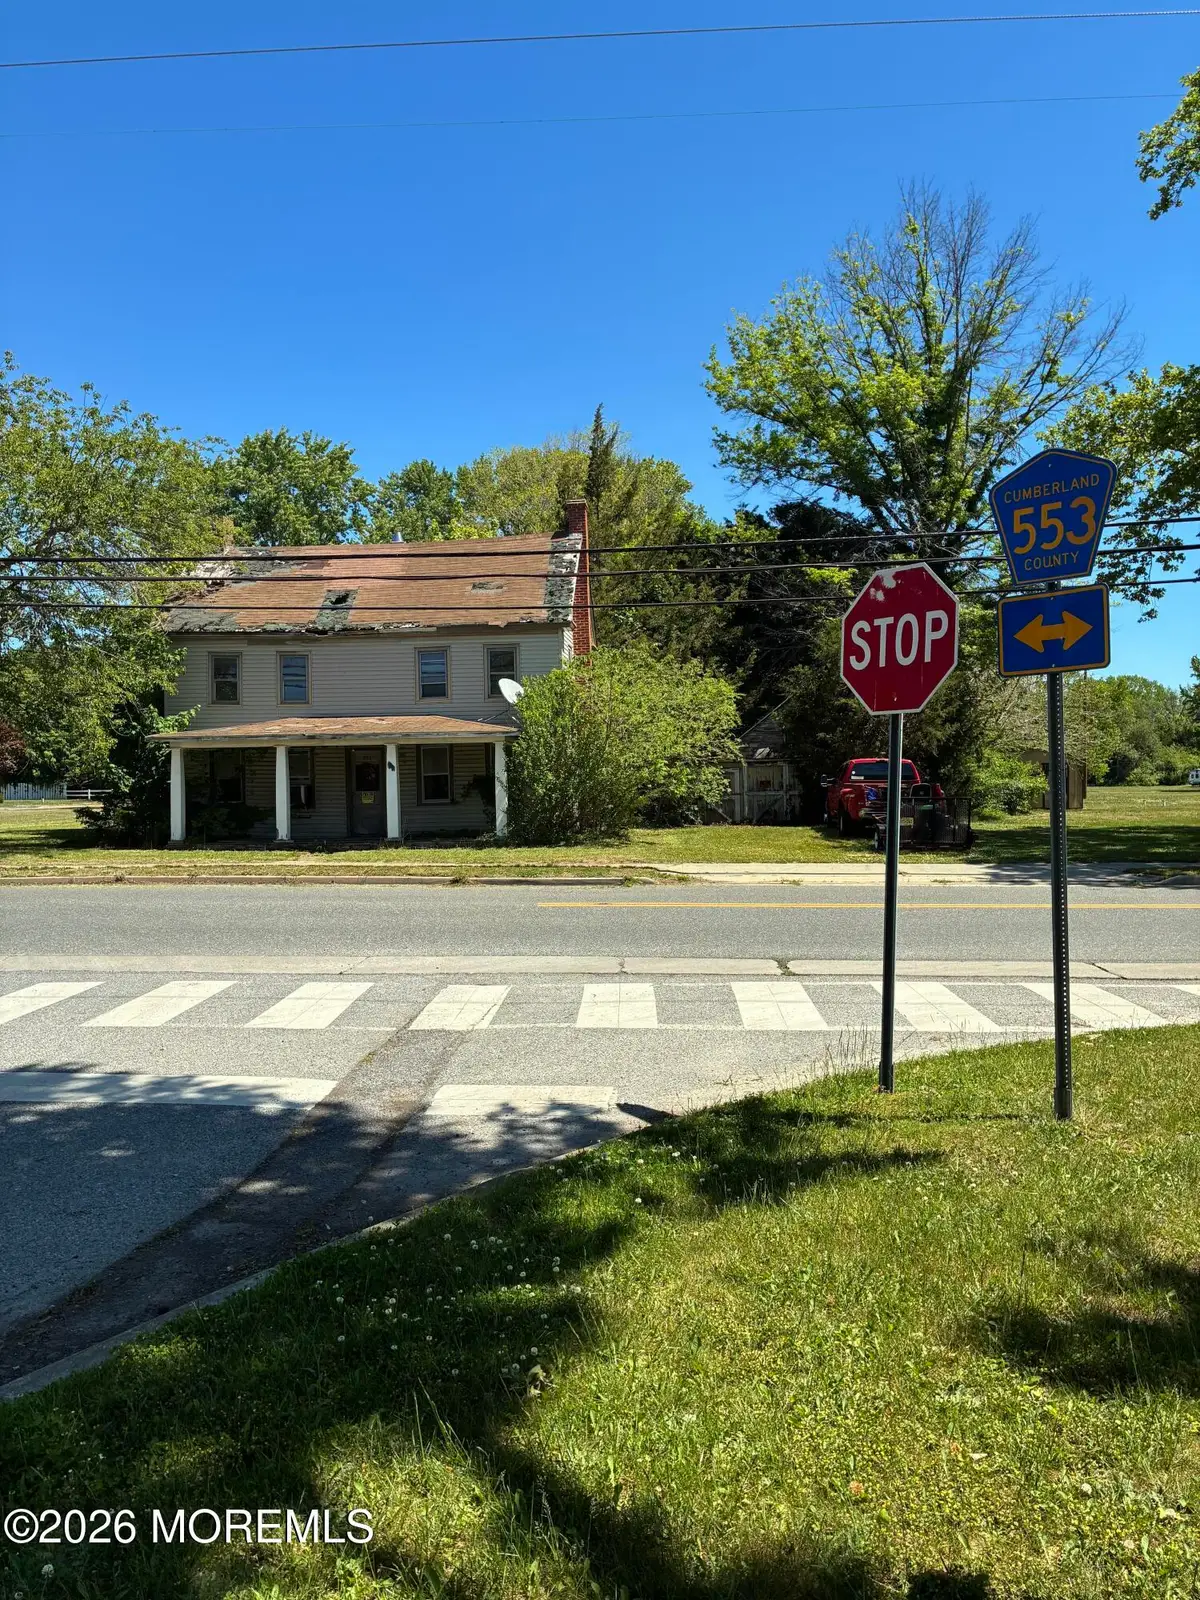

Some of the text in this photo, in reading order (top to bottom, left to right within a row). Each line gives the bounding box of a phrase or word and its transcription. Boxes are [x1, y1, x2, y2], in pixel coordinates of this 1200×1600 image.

[1004, 474, 1100, 503] CUMBERLAND
[1013, 496, 1096, 554] 553
[1024, 551, 1079, 571] COUNTY
[850, 609, 949, 671] STOP
